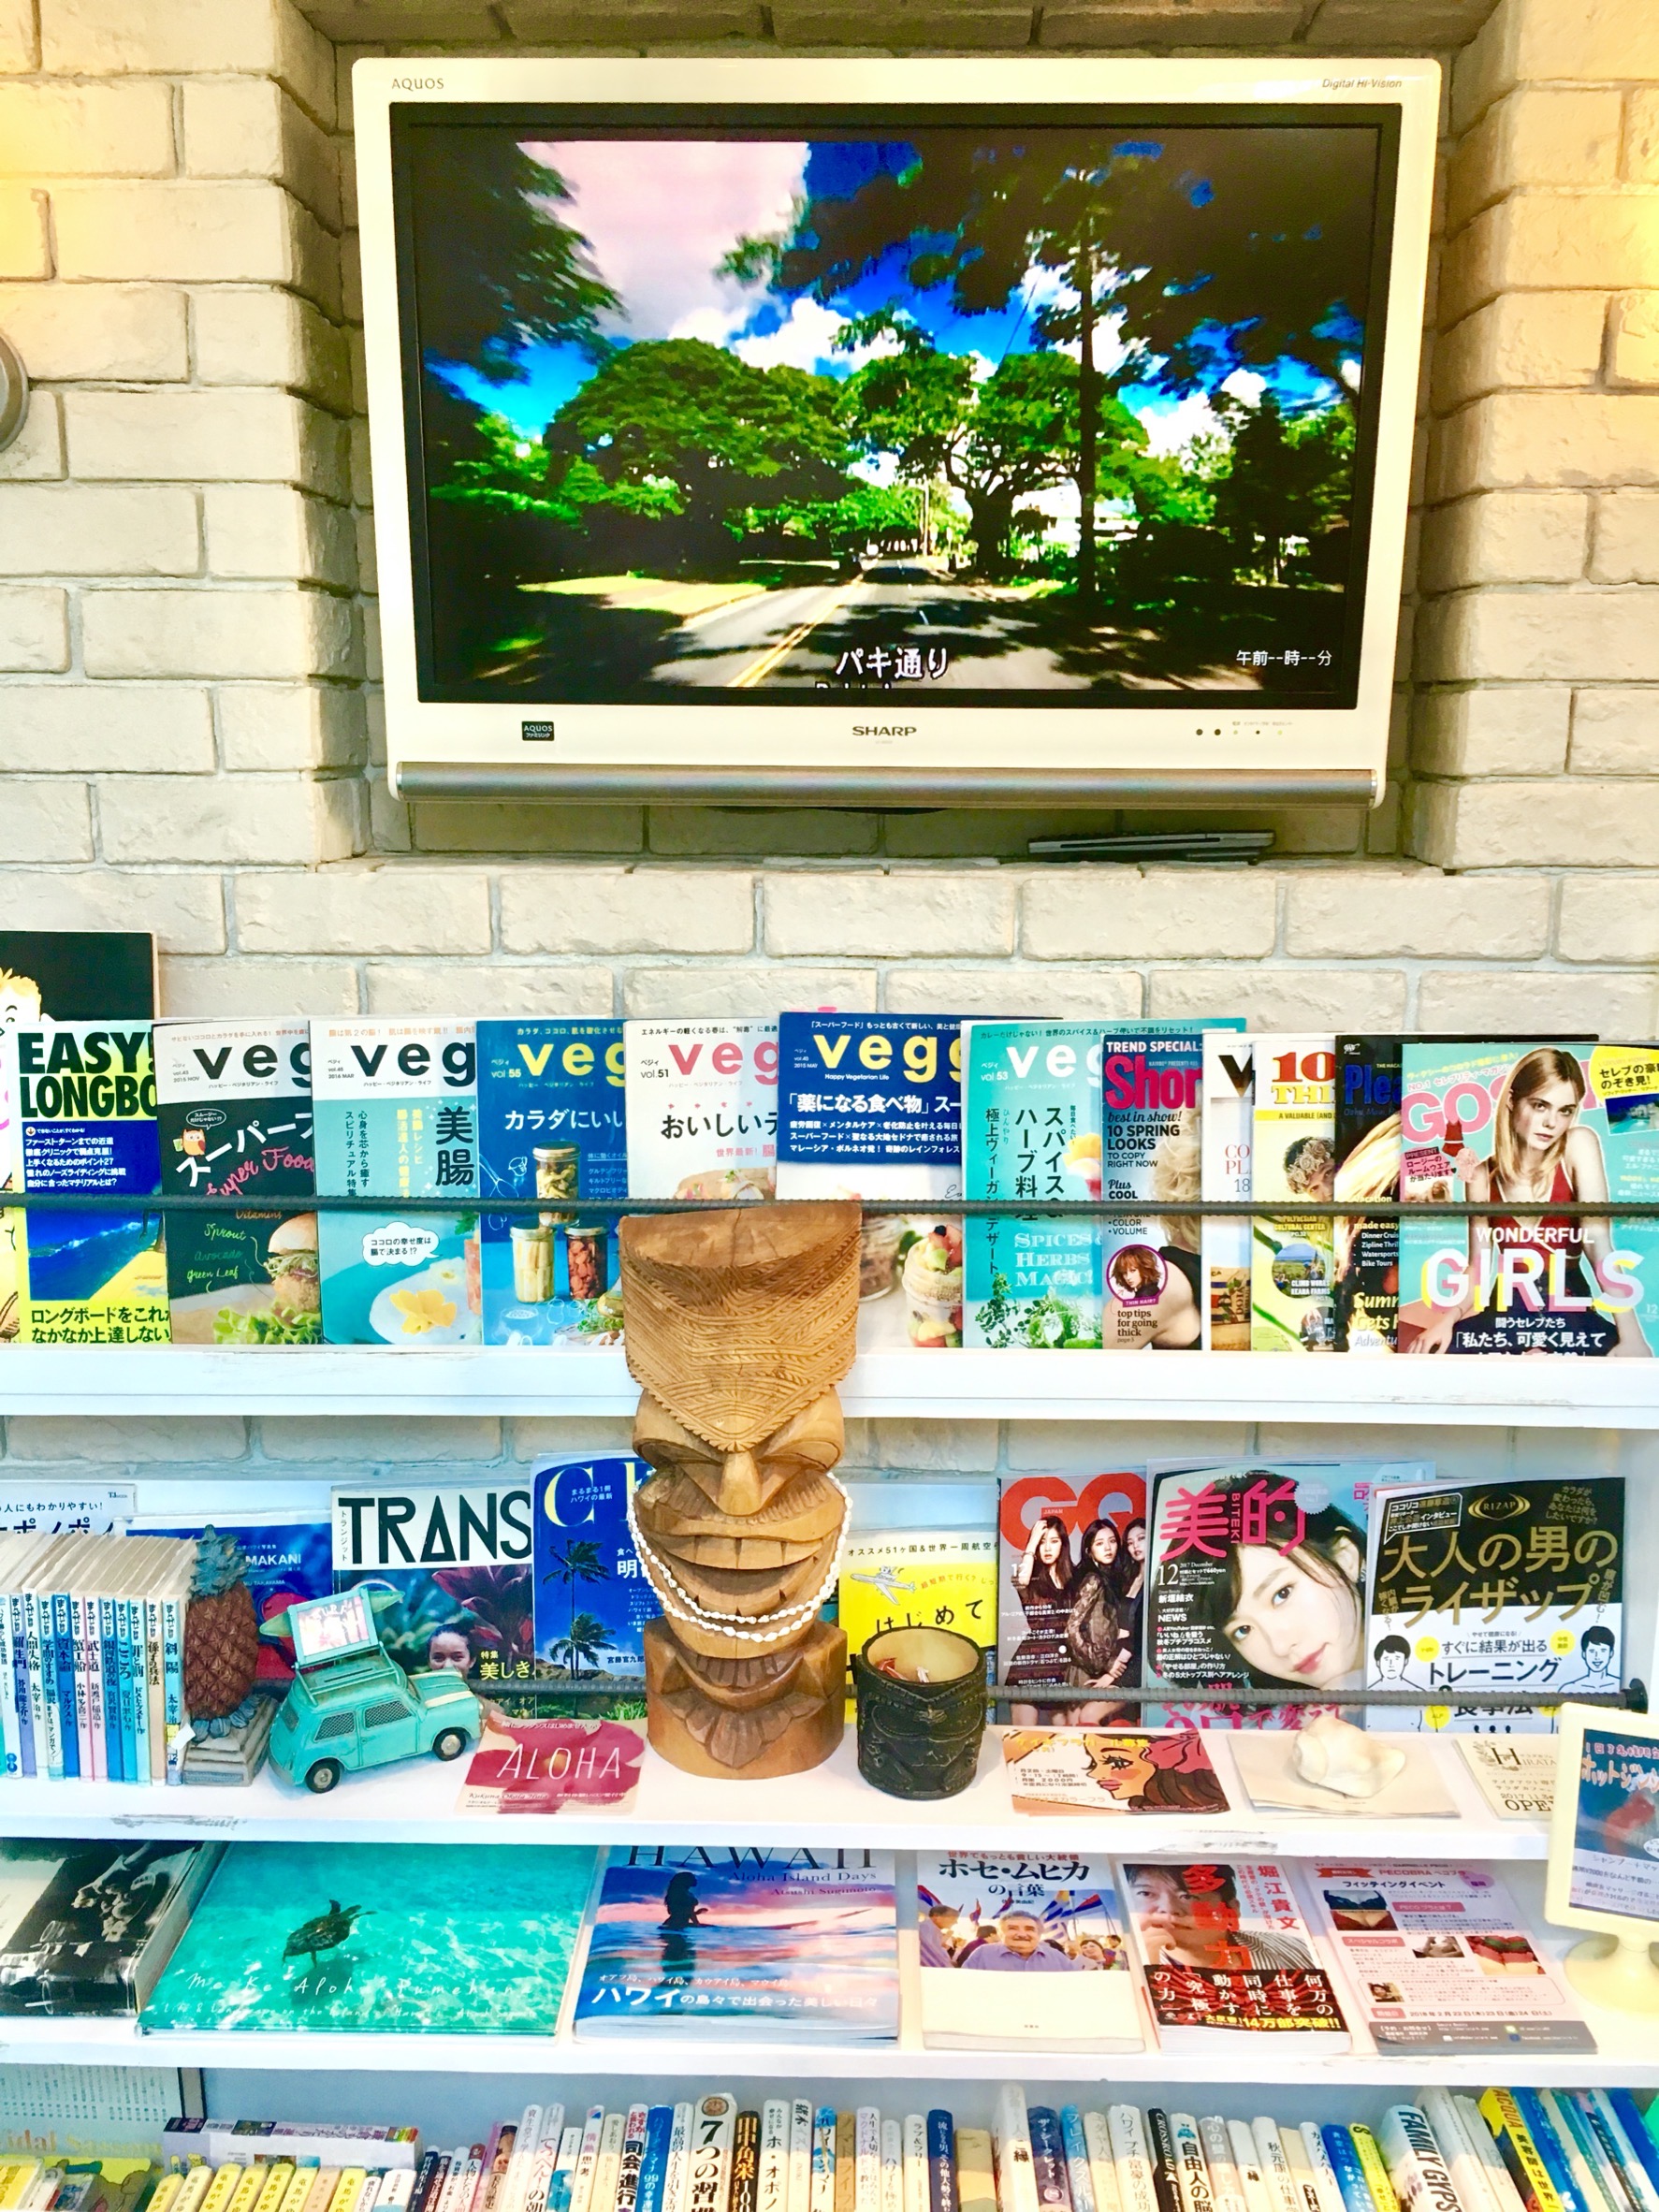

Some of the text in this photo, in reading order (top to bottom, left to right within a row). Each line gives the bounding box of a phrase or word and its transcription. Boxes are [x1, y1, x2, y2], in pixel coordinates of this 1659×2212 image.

[391, 78, 444, 92] AQUOS
[1322, 79, 1403, 91] Digital Hi-Vision
[836, 647, 950, 679] パキ通り
[523, 724, 554, 734] AQUOS
[851, 725, 918, 736] SHARP
[1106, 1041, 1147, 1054] TREND
[350, 1041, 476, 1087] veg
[640, 1069, 669, 1079] vol.51
[1601, 1076, 1652, 1090] のぞき見!
[1108, 1110, 1183, 1123] best in show!
[1284, 1112, 1316, 1120] VALUABLE
[1108, 1125, 1181, 1137] 10 SPRING
[435, 1105, 474, 1187] 美腸
[1108, 1138, 1157, 1150] LOOKS
[1405, 1147, 1439, 1159] PRESENT
[1135, 1159, 1158, 1168] NOW
[1406, 1157, 1442, 1169] ロージーの
[1108, 1179, 1132, 1190] Plus
[1109, 1191, 1139, 1200] COOL
[1113, 1218, 1142, 1227] COLOR
[1273, 1223, 1326, 1231] CULTURAL CENTER
[1354, 1221, 1379, 1230] made
[204, 1223, 247, 1241] Sprout
[1113, 1227, 1148, 1235] VOLUME
[1477, 1227, 1594, 1244] WONDERFUL
[371, 1236, 431, 1246] ココロの幸せ度は
[1361, 1241, 1383, 1249] Zipline
[1420, 1247, 1645, 1314] GIRLS
[1117, 1309, 1152, 1319] top tips
[1117, 1318, 1158, 1330] for going
[1355, 1315, 1390, 1331] Gets
[1494, 1317, 1566, 1329] 闘うセレブたち
[1117, 1328, 1142, 1336] thick
[570, 1492, 613, 1503] ハワイの最新
[1483, 1501, 1517, 1511] RIZAP
[1159, 1478, 1306, 1563] 美的
[1230, 1492, 1241, 1544] BITEKI
[1420, 1510, 1458, 1521] インタビュー
[338, 1491, 531, 1564] TRANS
[340, 1509, 348, 1562] トランジット
[244, 1553, 301, 1566] MAKANI
[1380, 1525, 1619, 1583] 大人の男の
[1011, 1564, 1028, 1578] 12
[1157, 1564, 1179, 1586] 12
[1158, 1594, 1194, 1604] 新垣結衣
[1401, 1572, 1601, 1629] ライザップ
[1157, 1613, 1187, 1623] NEWS
[1441, 1638, 1548, 1655] すぐに結果が出る
[118, 1640, 132, 1681] こころ
[480, 1651, 499, 1659] 特集
[1429, 1656, 1564, 1685] トレーニング
[496, 1742, 621, 1781] ALOHA
[939, 1858, 1090, 1883] ホセ・ムヒカ
[729, 1871, 878, 1884] Aloha Island Days
[819, 1886, 877, 1897] Sugimoto
[988, 1883, 1045, 1898] の言葉
[1257, 1864, 1301, 1930] 堀江貴文
[591, 1986, 878, 2009] ハワイの島々で出会った美しい日々
[1213, 1974, 1241, 2016] 動かす
[1242, 1974, 1273, 2016] 同時に
[1274, 1973, 1302, 2016] 仕事を
[1304, 1973, 1334, 2016] 何万の
[1243, 2016, 1342, 2030] 14万部突破!!
[1398, 2111, 1445, 2168] FAMILY
[734, 2117, 757, 2180] 田中角栄
[691, 2120, 724, 2212] 7つの習
